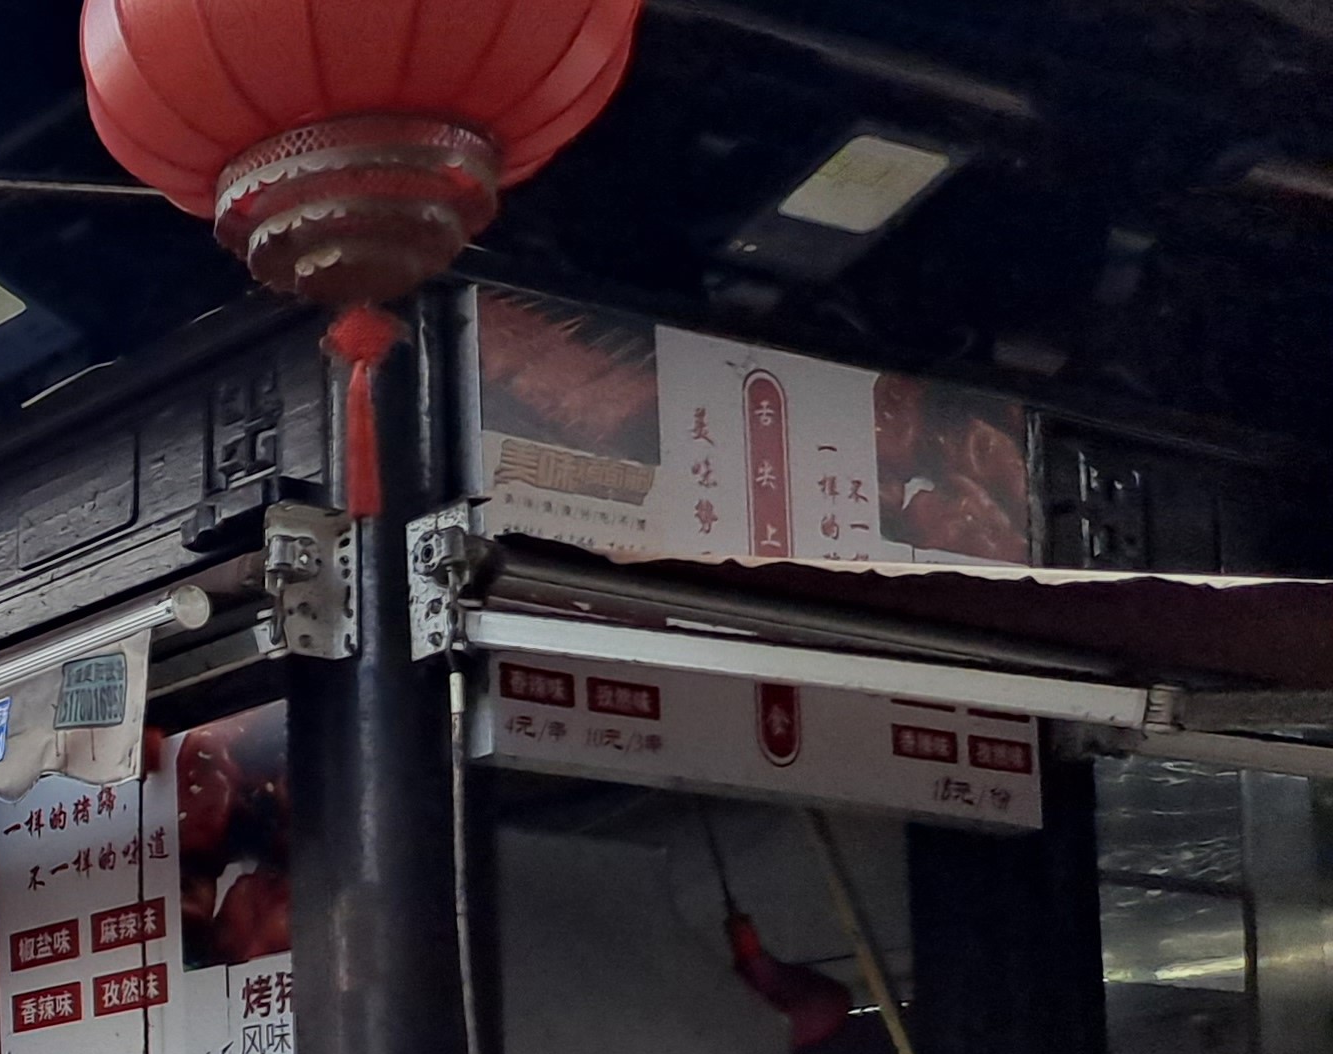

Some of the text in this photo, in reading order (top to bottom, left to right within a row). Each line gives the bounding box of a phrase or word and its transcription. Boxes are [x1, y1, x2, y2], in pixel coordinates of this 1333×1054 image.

[817, 445, 840, 560] 一样的
[27, 825, 170, 891] 不一样的味道
[99, 906, 157, 944] 麻辣味
[18, 928, 72, 963] 椒盐味
[20, 990, 74, 1026] 香辣味
[101, 972, 160, 1008] 孜然味
